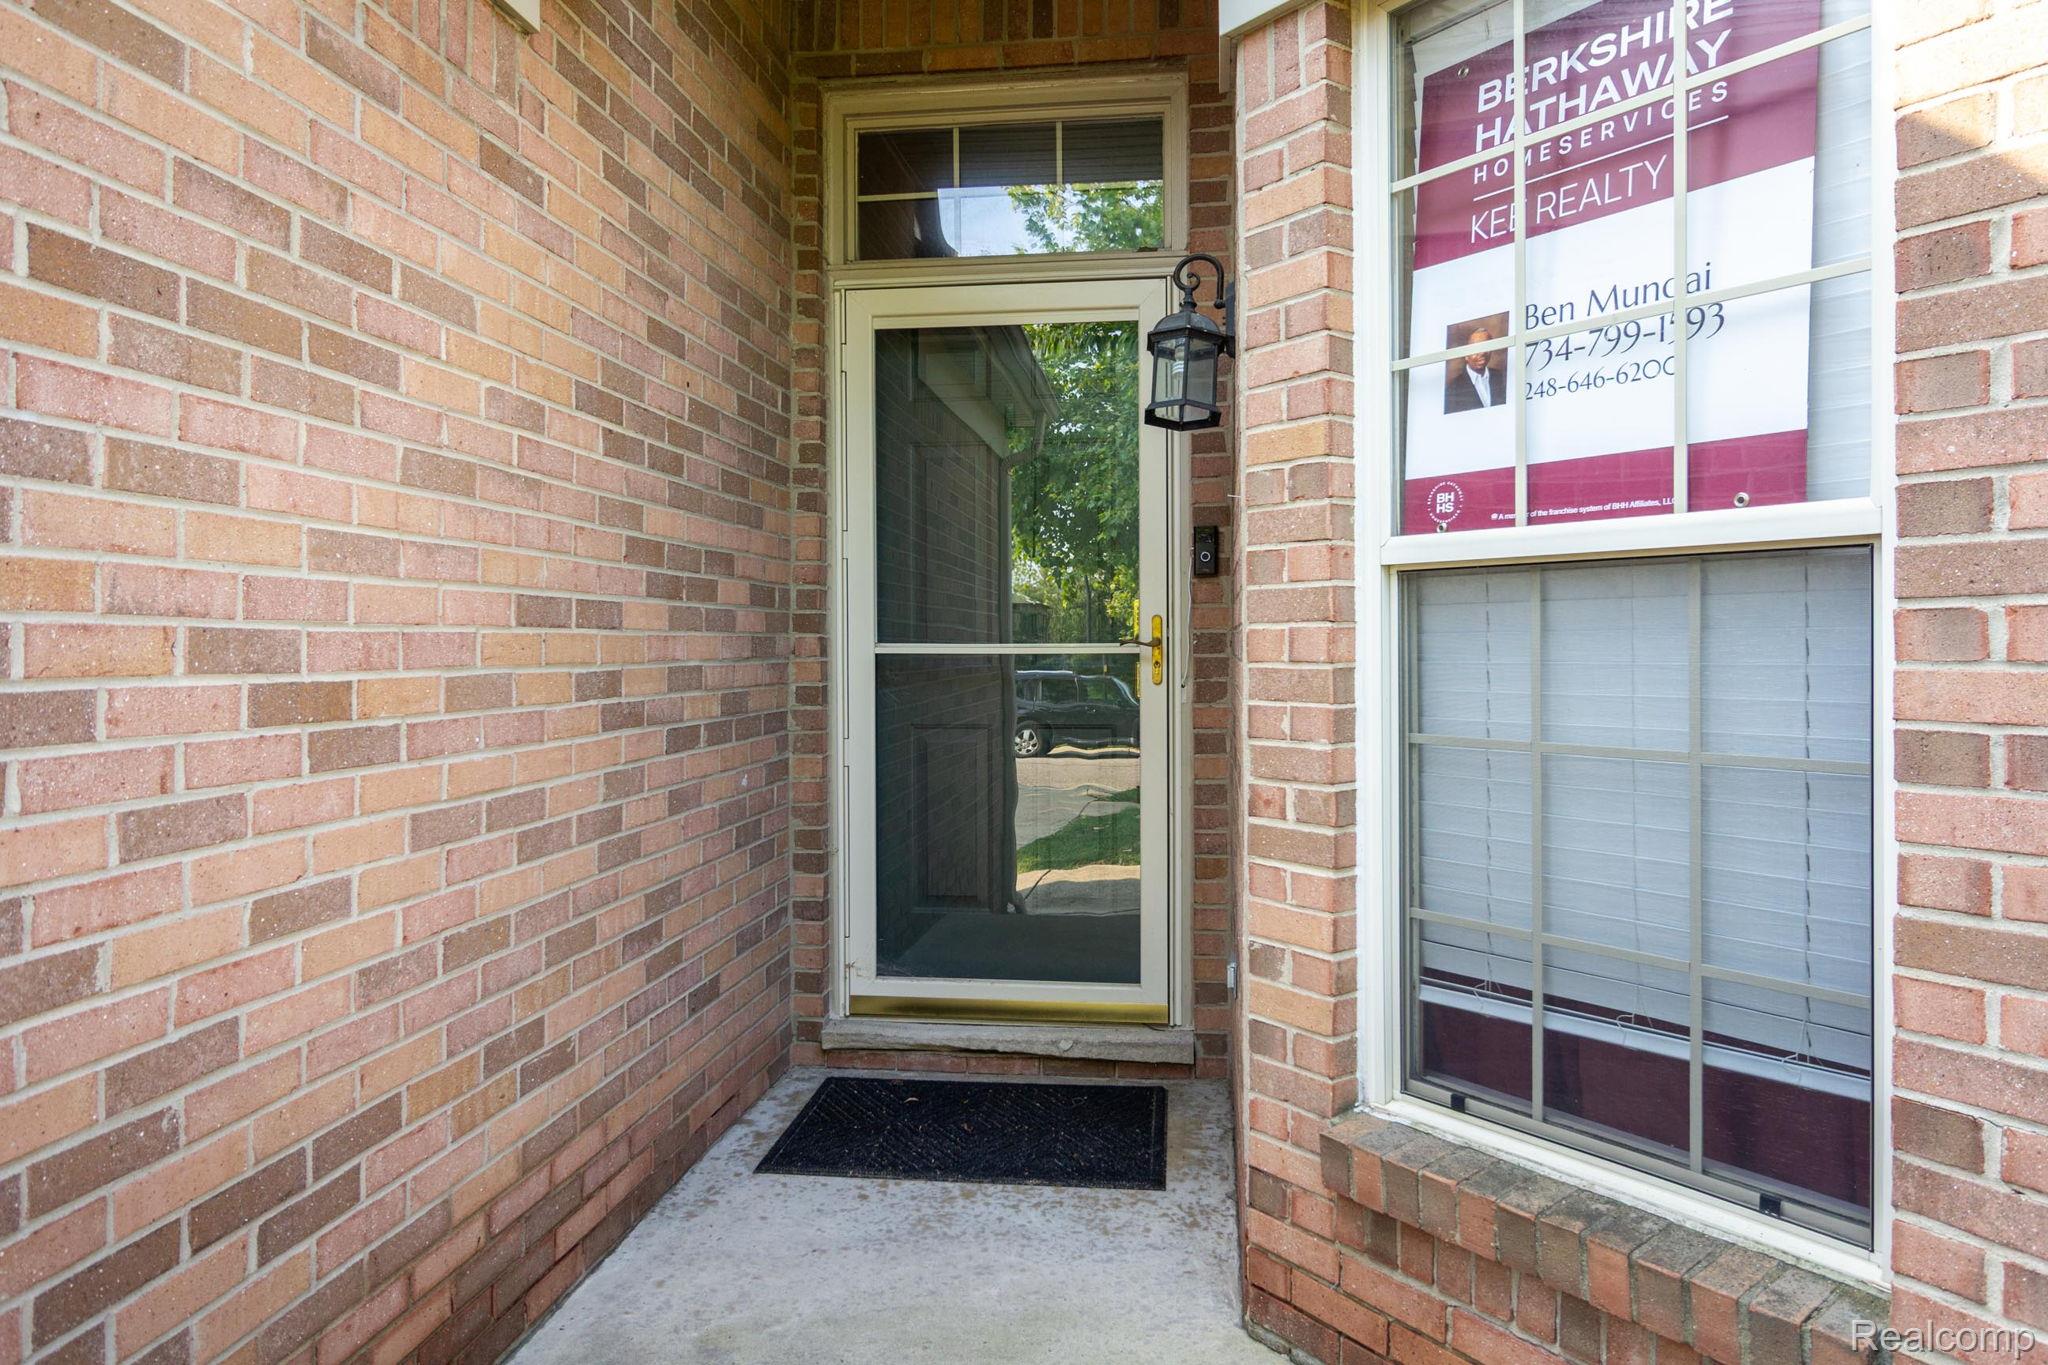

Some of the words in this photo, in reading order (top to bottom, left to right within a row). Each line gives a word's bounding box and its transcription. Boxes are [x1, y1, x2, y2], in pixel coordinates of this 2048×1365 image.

[1478, 0, 1733, 113] BERKSHIRE
[1475, 29, 1732, 153] HATHAWAY
[1536, 154, 1669, 225] REALTY
[1525, 301, 1575, 331] Ben
[1525, 302, 1726, 372] 734-799-193
[1436, 502, 1455, 514] HS
[1437, 491, 1455, 503] BH
[1579, 505, 1603, 514] system
